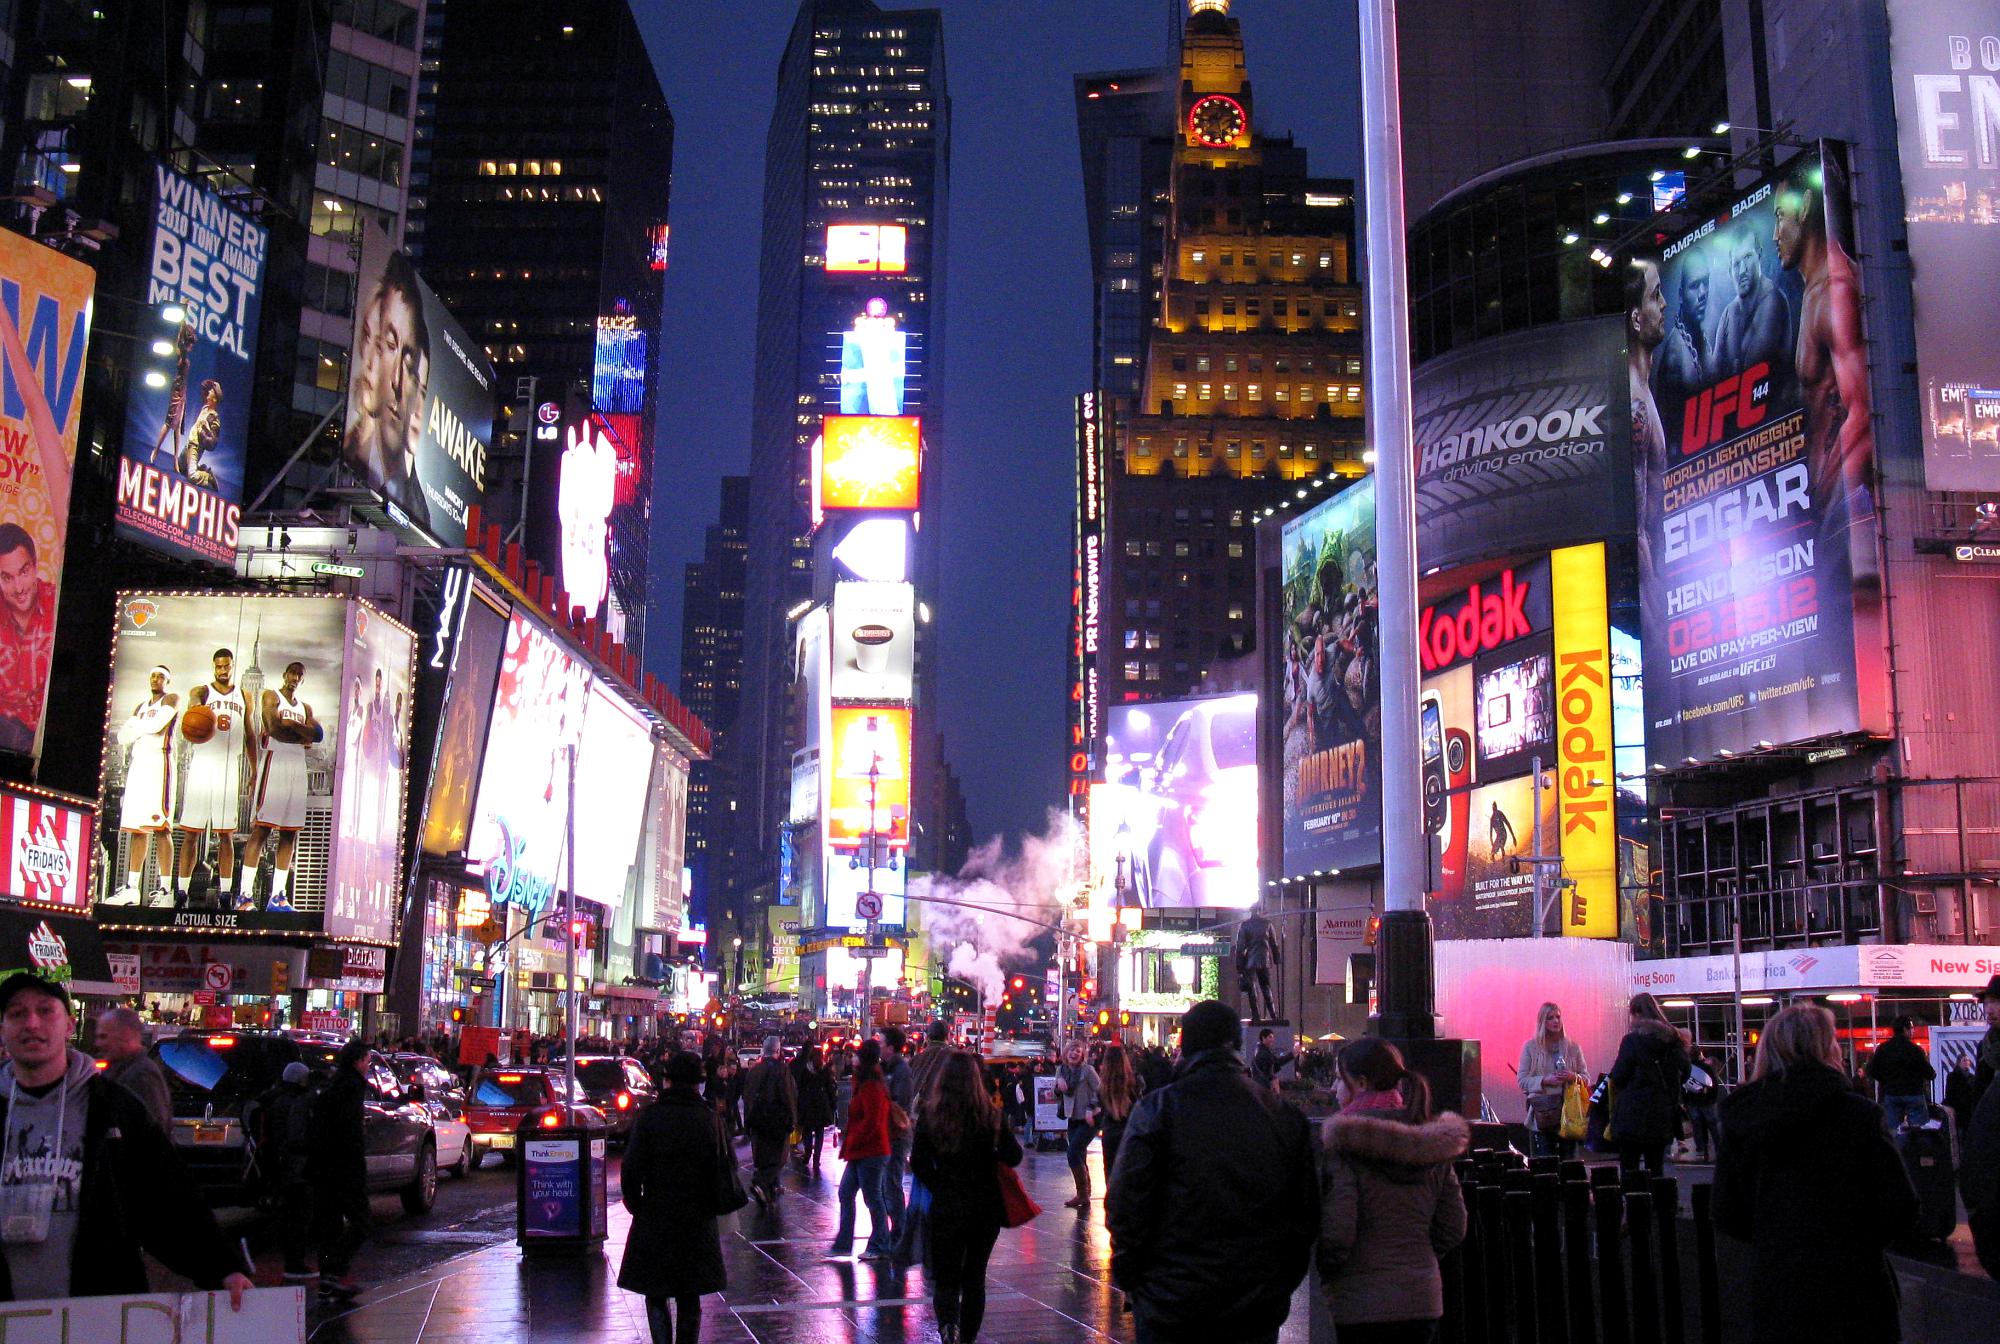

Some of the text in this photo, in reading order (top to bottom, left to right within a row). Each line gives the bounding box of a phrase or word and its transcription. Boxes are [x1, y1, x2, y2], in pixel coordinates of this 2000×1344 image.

[158, 165, 265, 261] WINNER!
[1663, 184, 1771, 262] RAMPAGE BADER
[158, 202, 259, 281] 2010 TONY AWARD
[152, 226, 256, 327] BEST
[1682, 361, 1770, 456] UFC 144
[427, 393, 488, 494] AWAKE
[537, 426, 558, 440] LG
[1662, 415, 1803, 491] WORLD LIGHTWEIGHT
[1086, 422, 1097, 520] engage opportunity
[1443, 440, 1605, 483] driving emotion
[1663, 434, 1806, 513] CHAMPIONSHIP
[117, 457, 241, 548] MEMPHIS
[1663, 463, 1811, 564] EDGAR
[119, 505, 185, 538] TELECHARGE.COM
[192, 535, 236, 558] 212-239-6200
[1085, 535, 1099, 653] PR Newswire
[1419, 569, 1533, 672] Kodak
[1671, 615, 1819, 673] LIVE ON PAY-PER-VIEW
[1698, 674, 1710, 687] ALSO
[1739, 658, 1761, 677] UFC
[223, 701, 243, 715] YORK
[1682, 694, 1745, 721] facebook.com/UFC
[1757, 675, 1816, 702] twitter.com/ufc
[217, 715, 231, 732] 6
[1560, 648, 1608, 836] Kodak
[1303, 815, 1332, 831] FEBRUARY
[1475, 881, 1488, 891] BUILT
[1489, 879, 1499, 889] FOR
[1500, 877, 1510, 888] THE
[1511, 875, 1523, 886] WAY
[174, 913, 238, 927] ACTUAL SIZE
[773, 935, 796, 945] LIVE
[1323, 920, 1362, 929] Marriott
[347, 946, 378, 967] DIGITAL
[773, 955, 791, 965] THE
[1652, 971, 1675, 984] Soon
[1706, 967, 1730, 982] Bank
[1930, 959, 1969, 974] New
[315, 1017, 350, 1029] TATTOO
[532, 1180, 574, 1189] Think with
[532, 1189, 551, 1199] your
